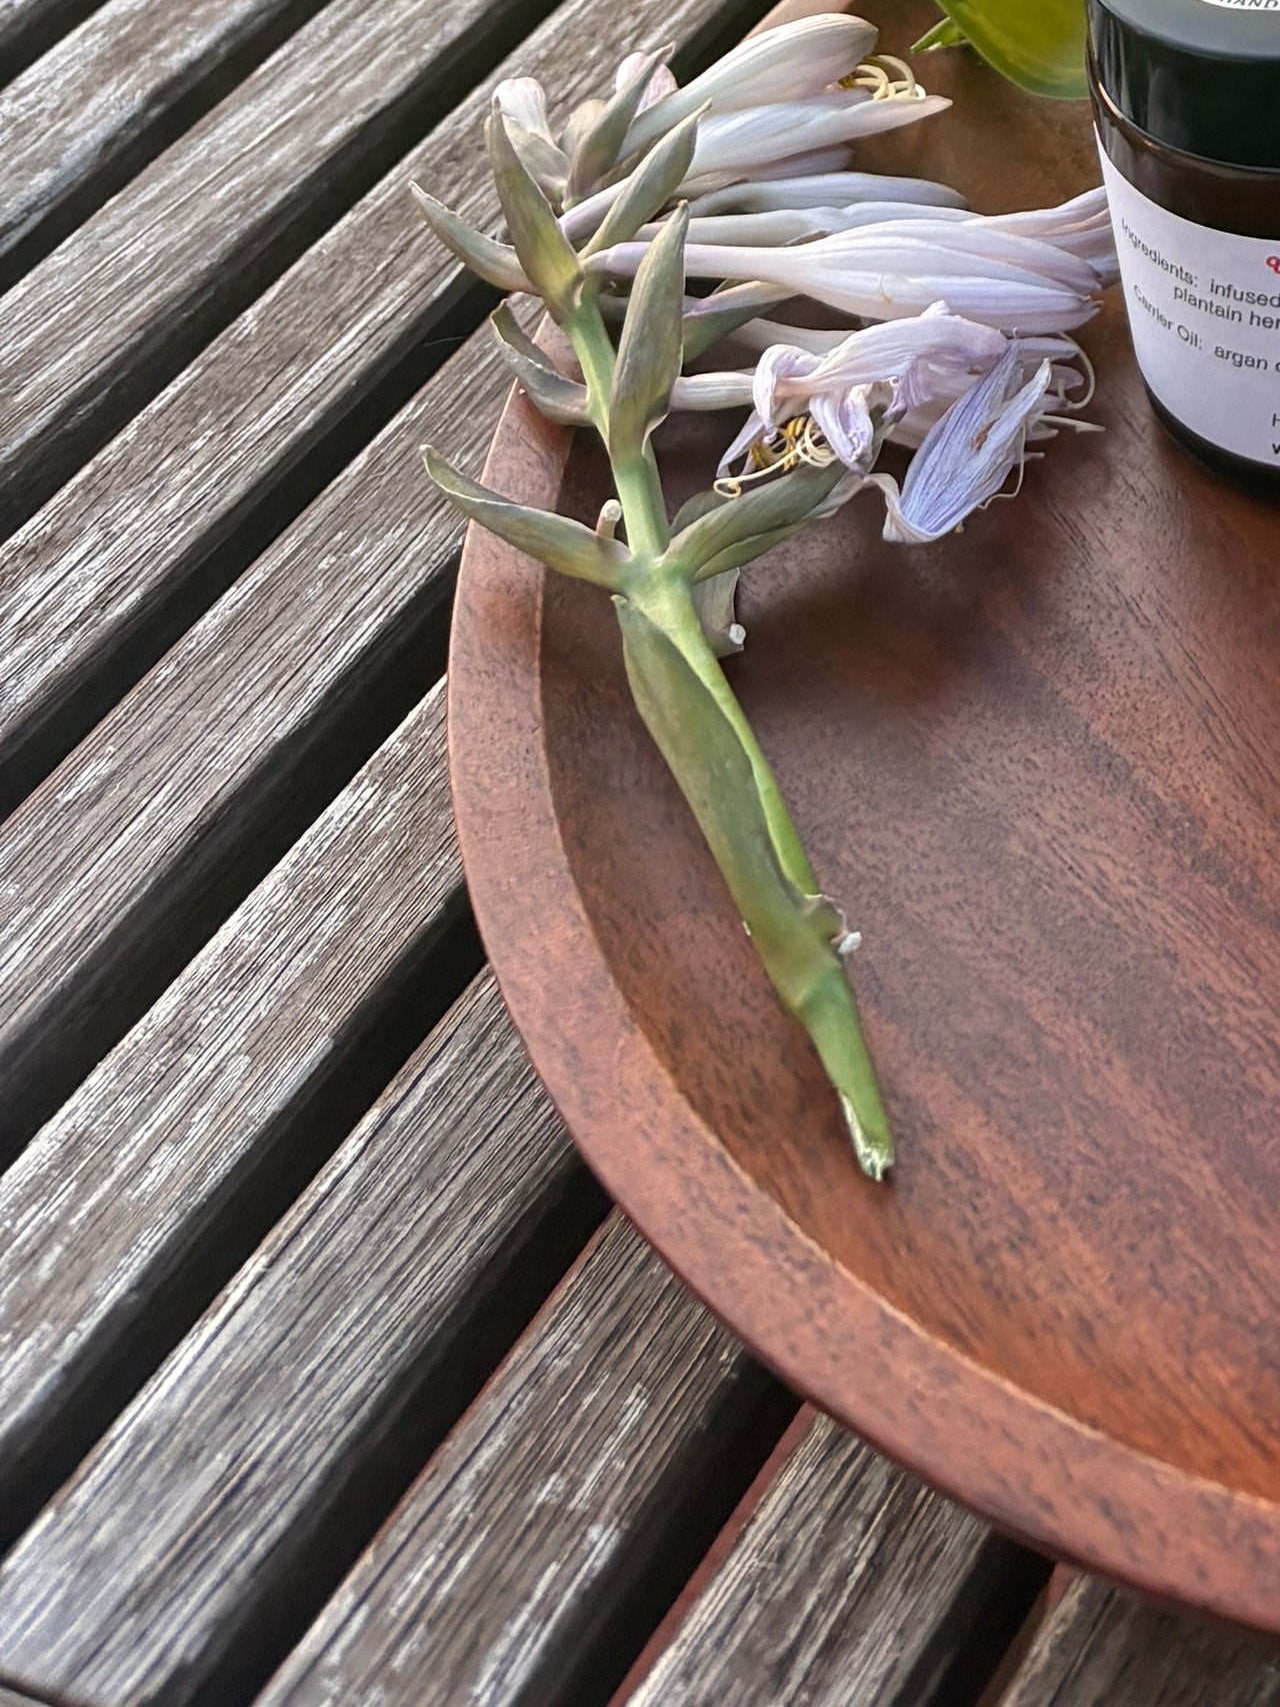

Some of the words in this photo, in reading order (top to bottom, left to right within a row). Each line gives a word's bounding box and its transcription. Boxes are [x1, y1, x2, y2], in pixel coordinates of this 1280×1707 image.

[1122, 217, 1198, 287] Ingredients:
[1174, 287, 1242, 322] plantain
[1177, 324, 1202, 350] Oil:
[1214, 345, 1268, 370] argan
